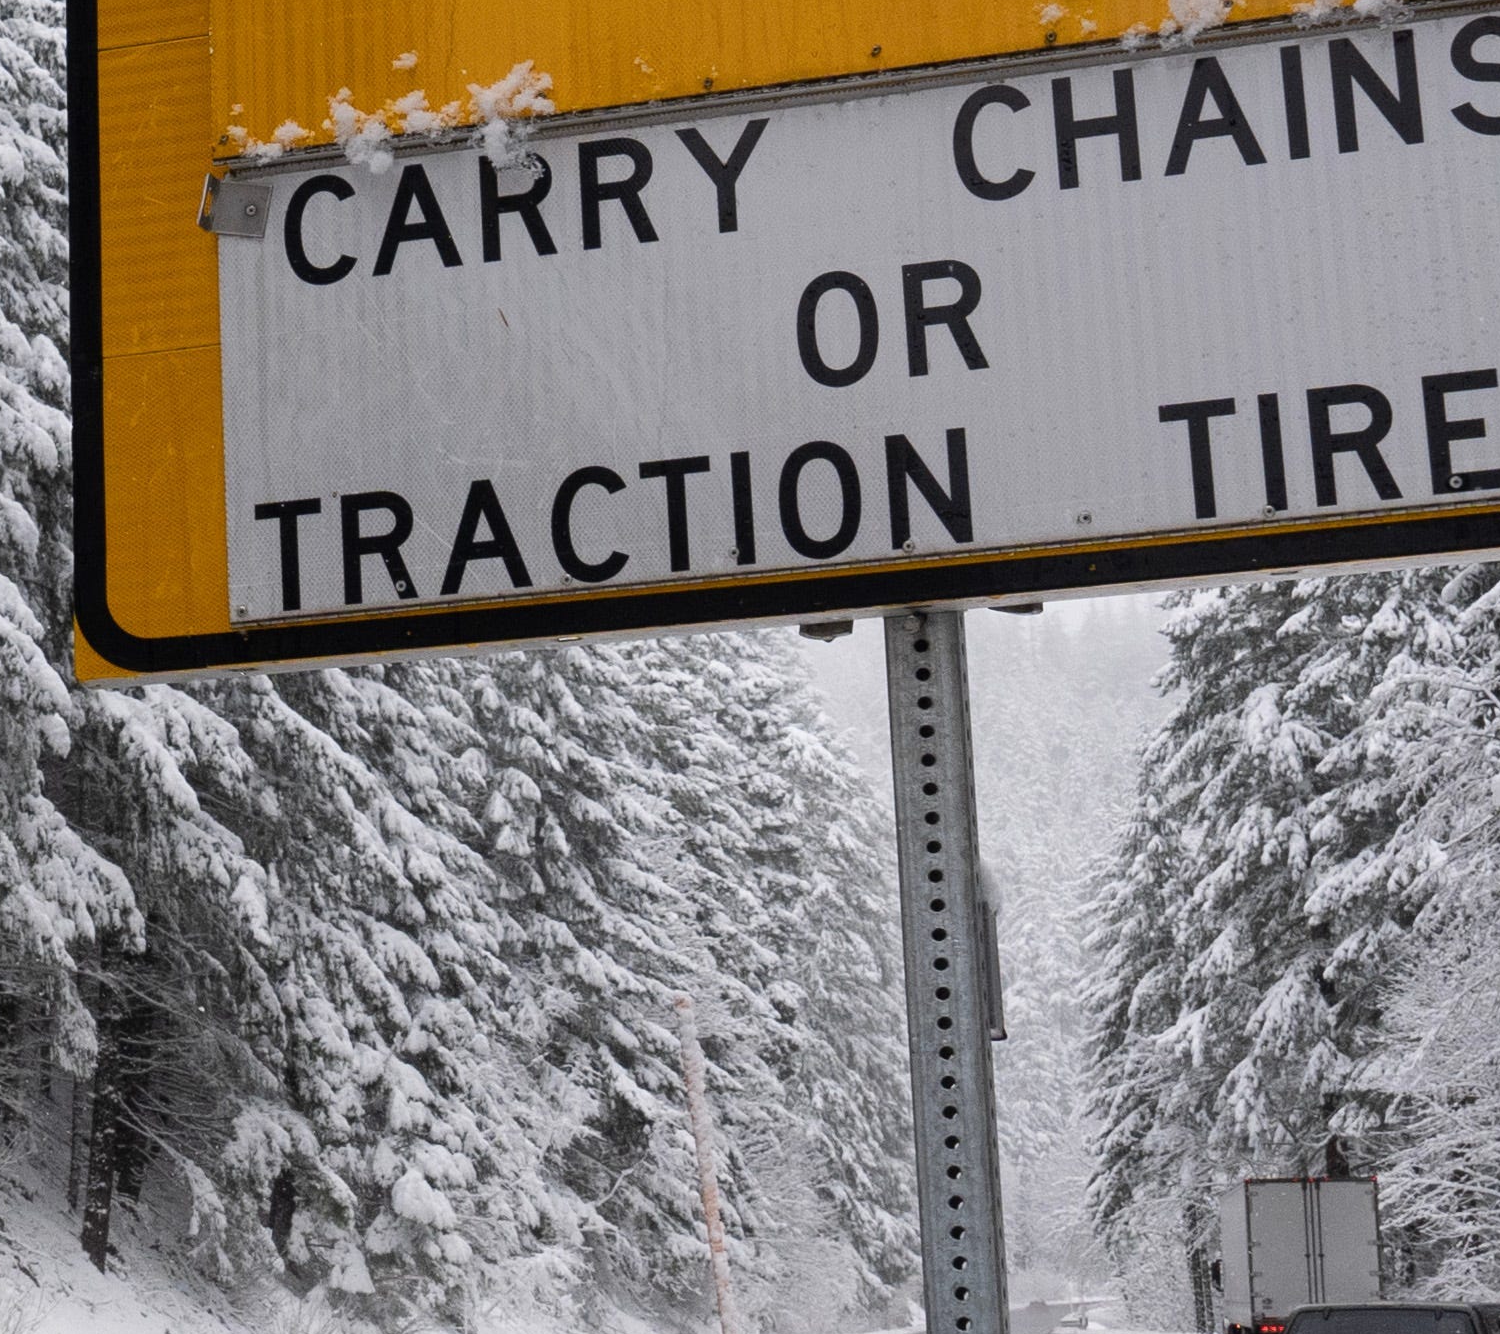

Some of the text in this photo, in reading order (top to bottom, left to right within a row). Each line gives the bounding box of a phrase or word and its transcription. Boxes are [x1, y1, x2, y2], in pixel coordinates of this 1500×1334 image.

[284, 118, 770, 286] CARRY
[797, 260, 989, 387] OR
[254, 428, 974, 611] TRACTION
